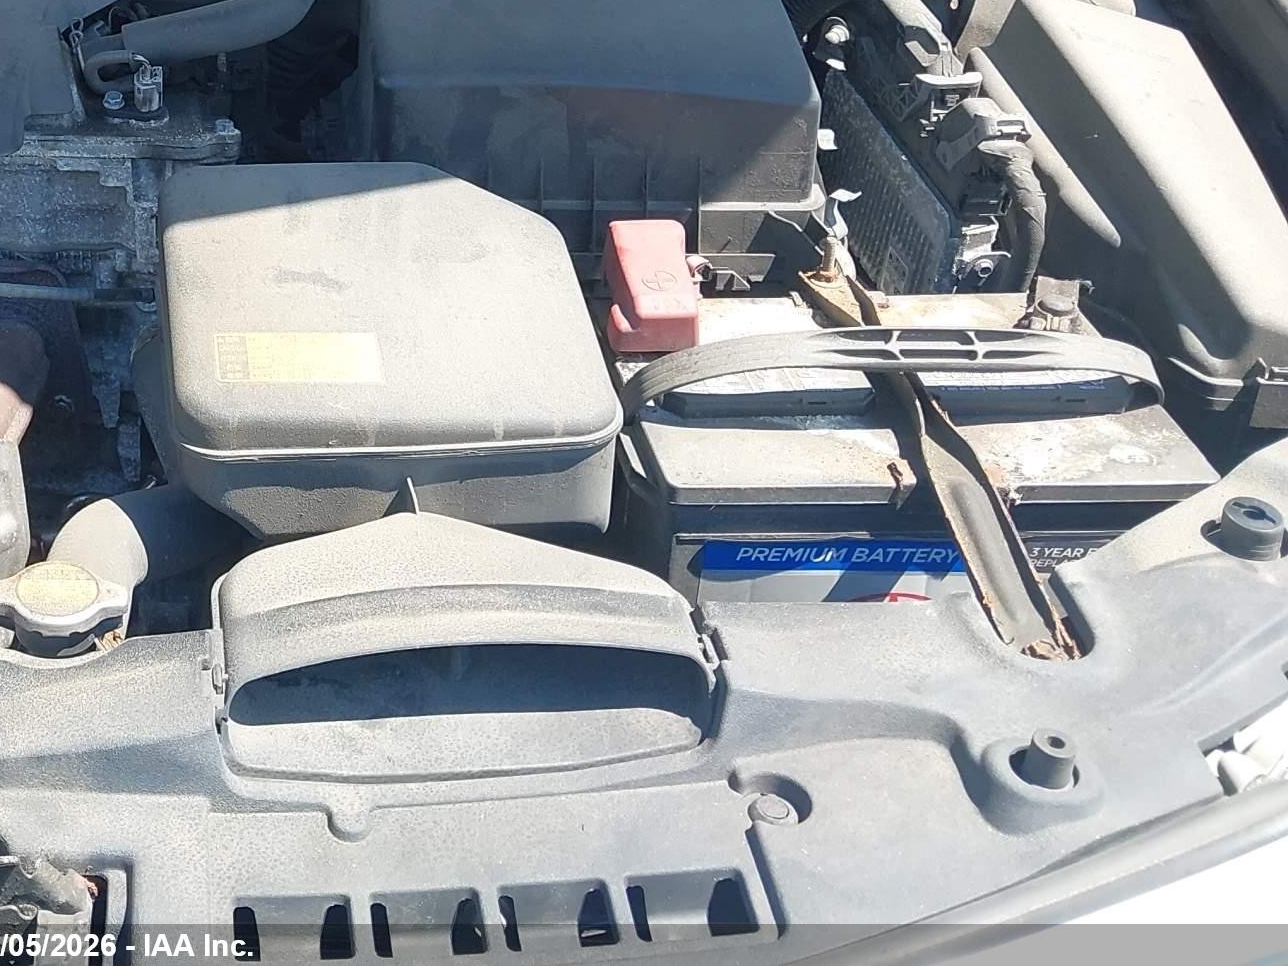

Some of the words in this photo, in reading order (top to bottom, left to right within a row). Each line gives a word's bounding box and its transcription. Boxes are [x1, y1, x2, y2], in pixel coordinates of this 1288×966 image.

[736, 547, 847, 562] PREMIUM
[851, 547, 960, 563] BATTERY
[1029, 547, 1040, 557] 3
[1042, 547, 1084, 557] YEAR
